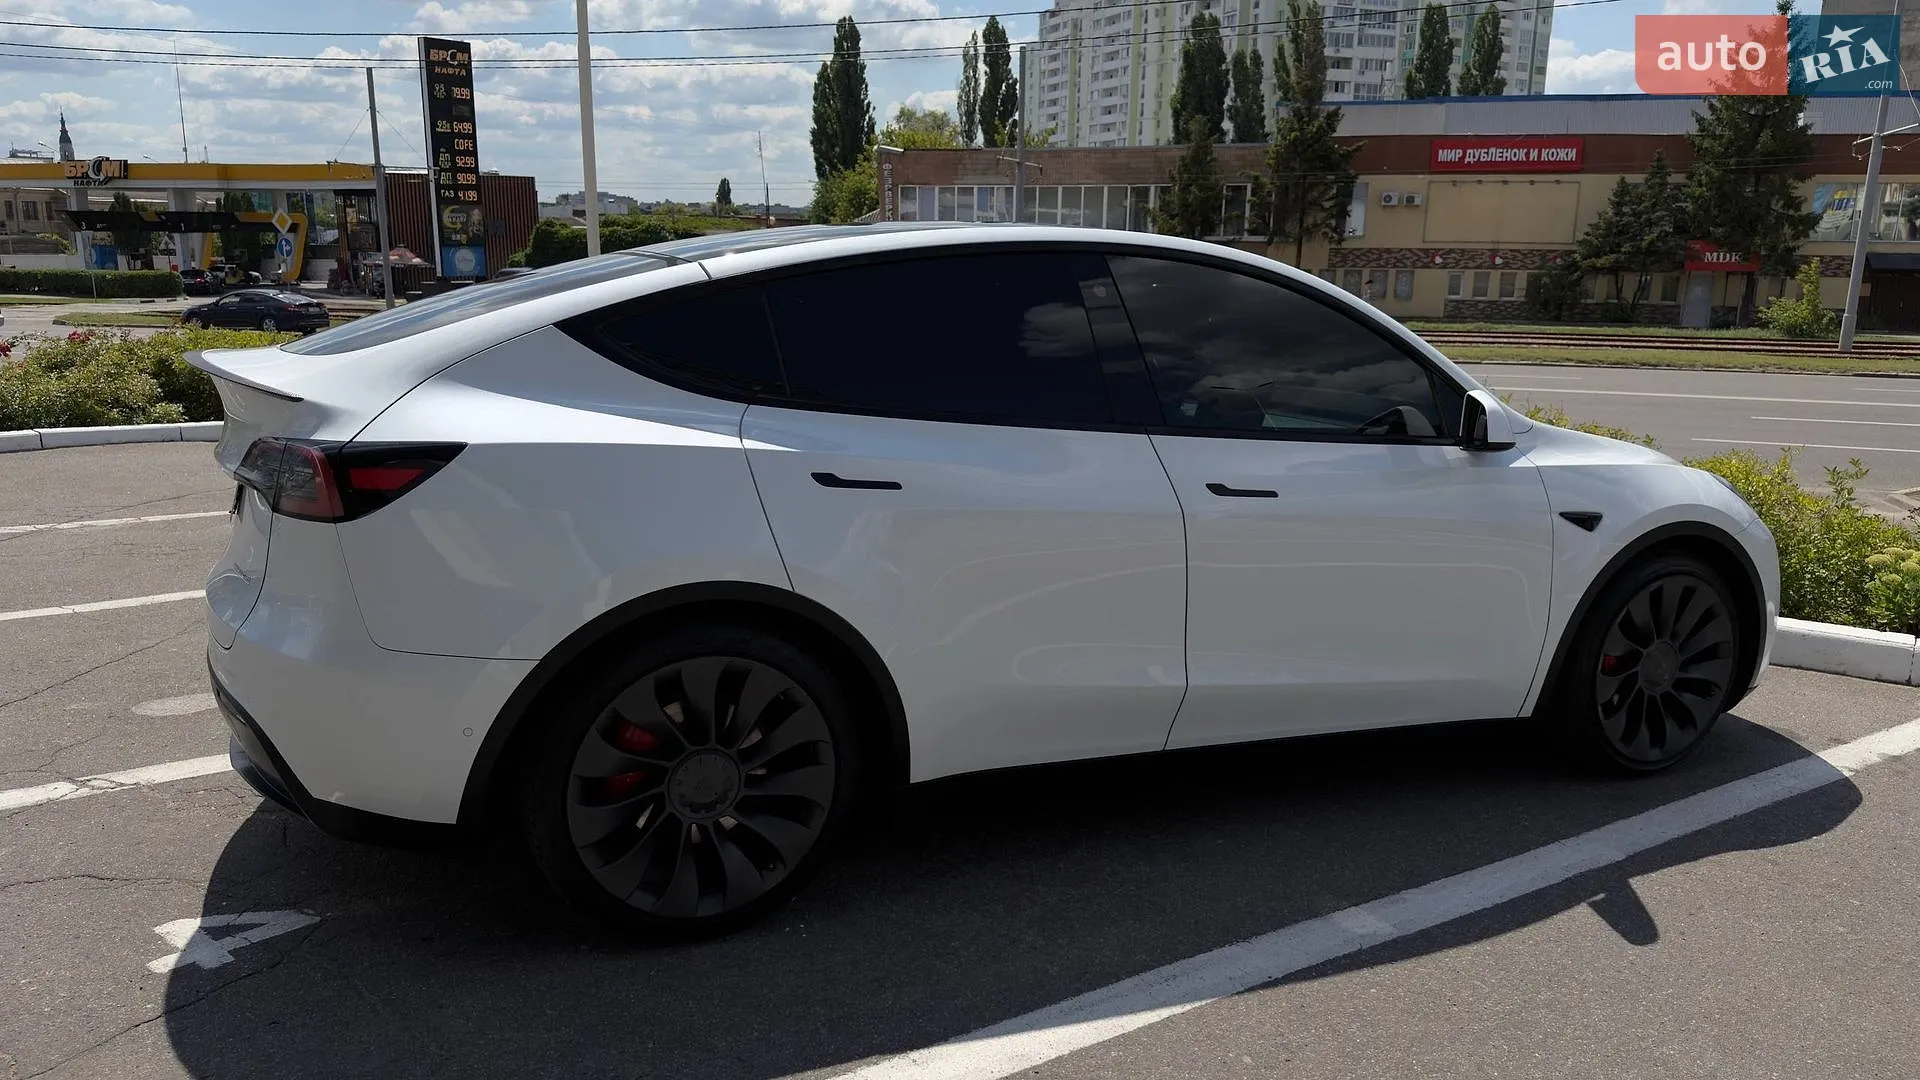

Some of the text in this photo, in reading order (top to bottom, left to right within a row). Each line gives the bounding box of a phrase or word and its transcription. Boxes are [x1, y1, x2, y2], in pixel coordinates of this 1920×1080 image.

[434, 66, 467, 76] НАФТА
[454, 138, 474, 150] COFE
[1438, 147, 1577, 164] МИР ДУБЛЕНОК И КОЖИ
